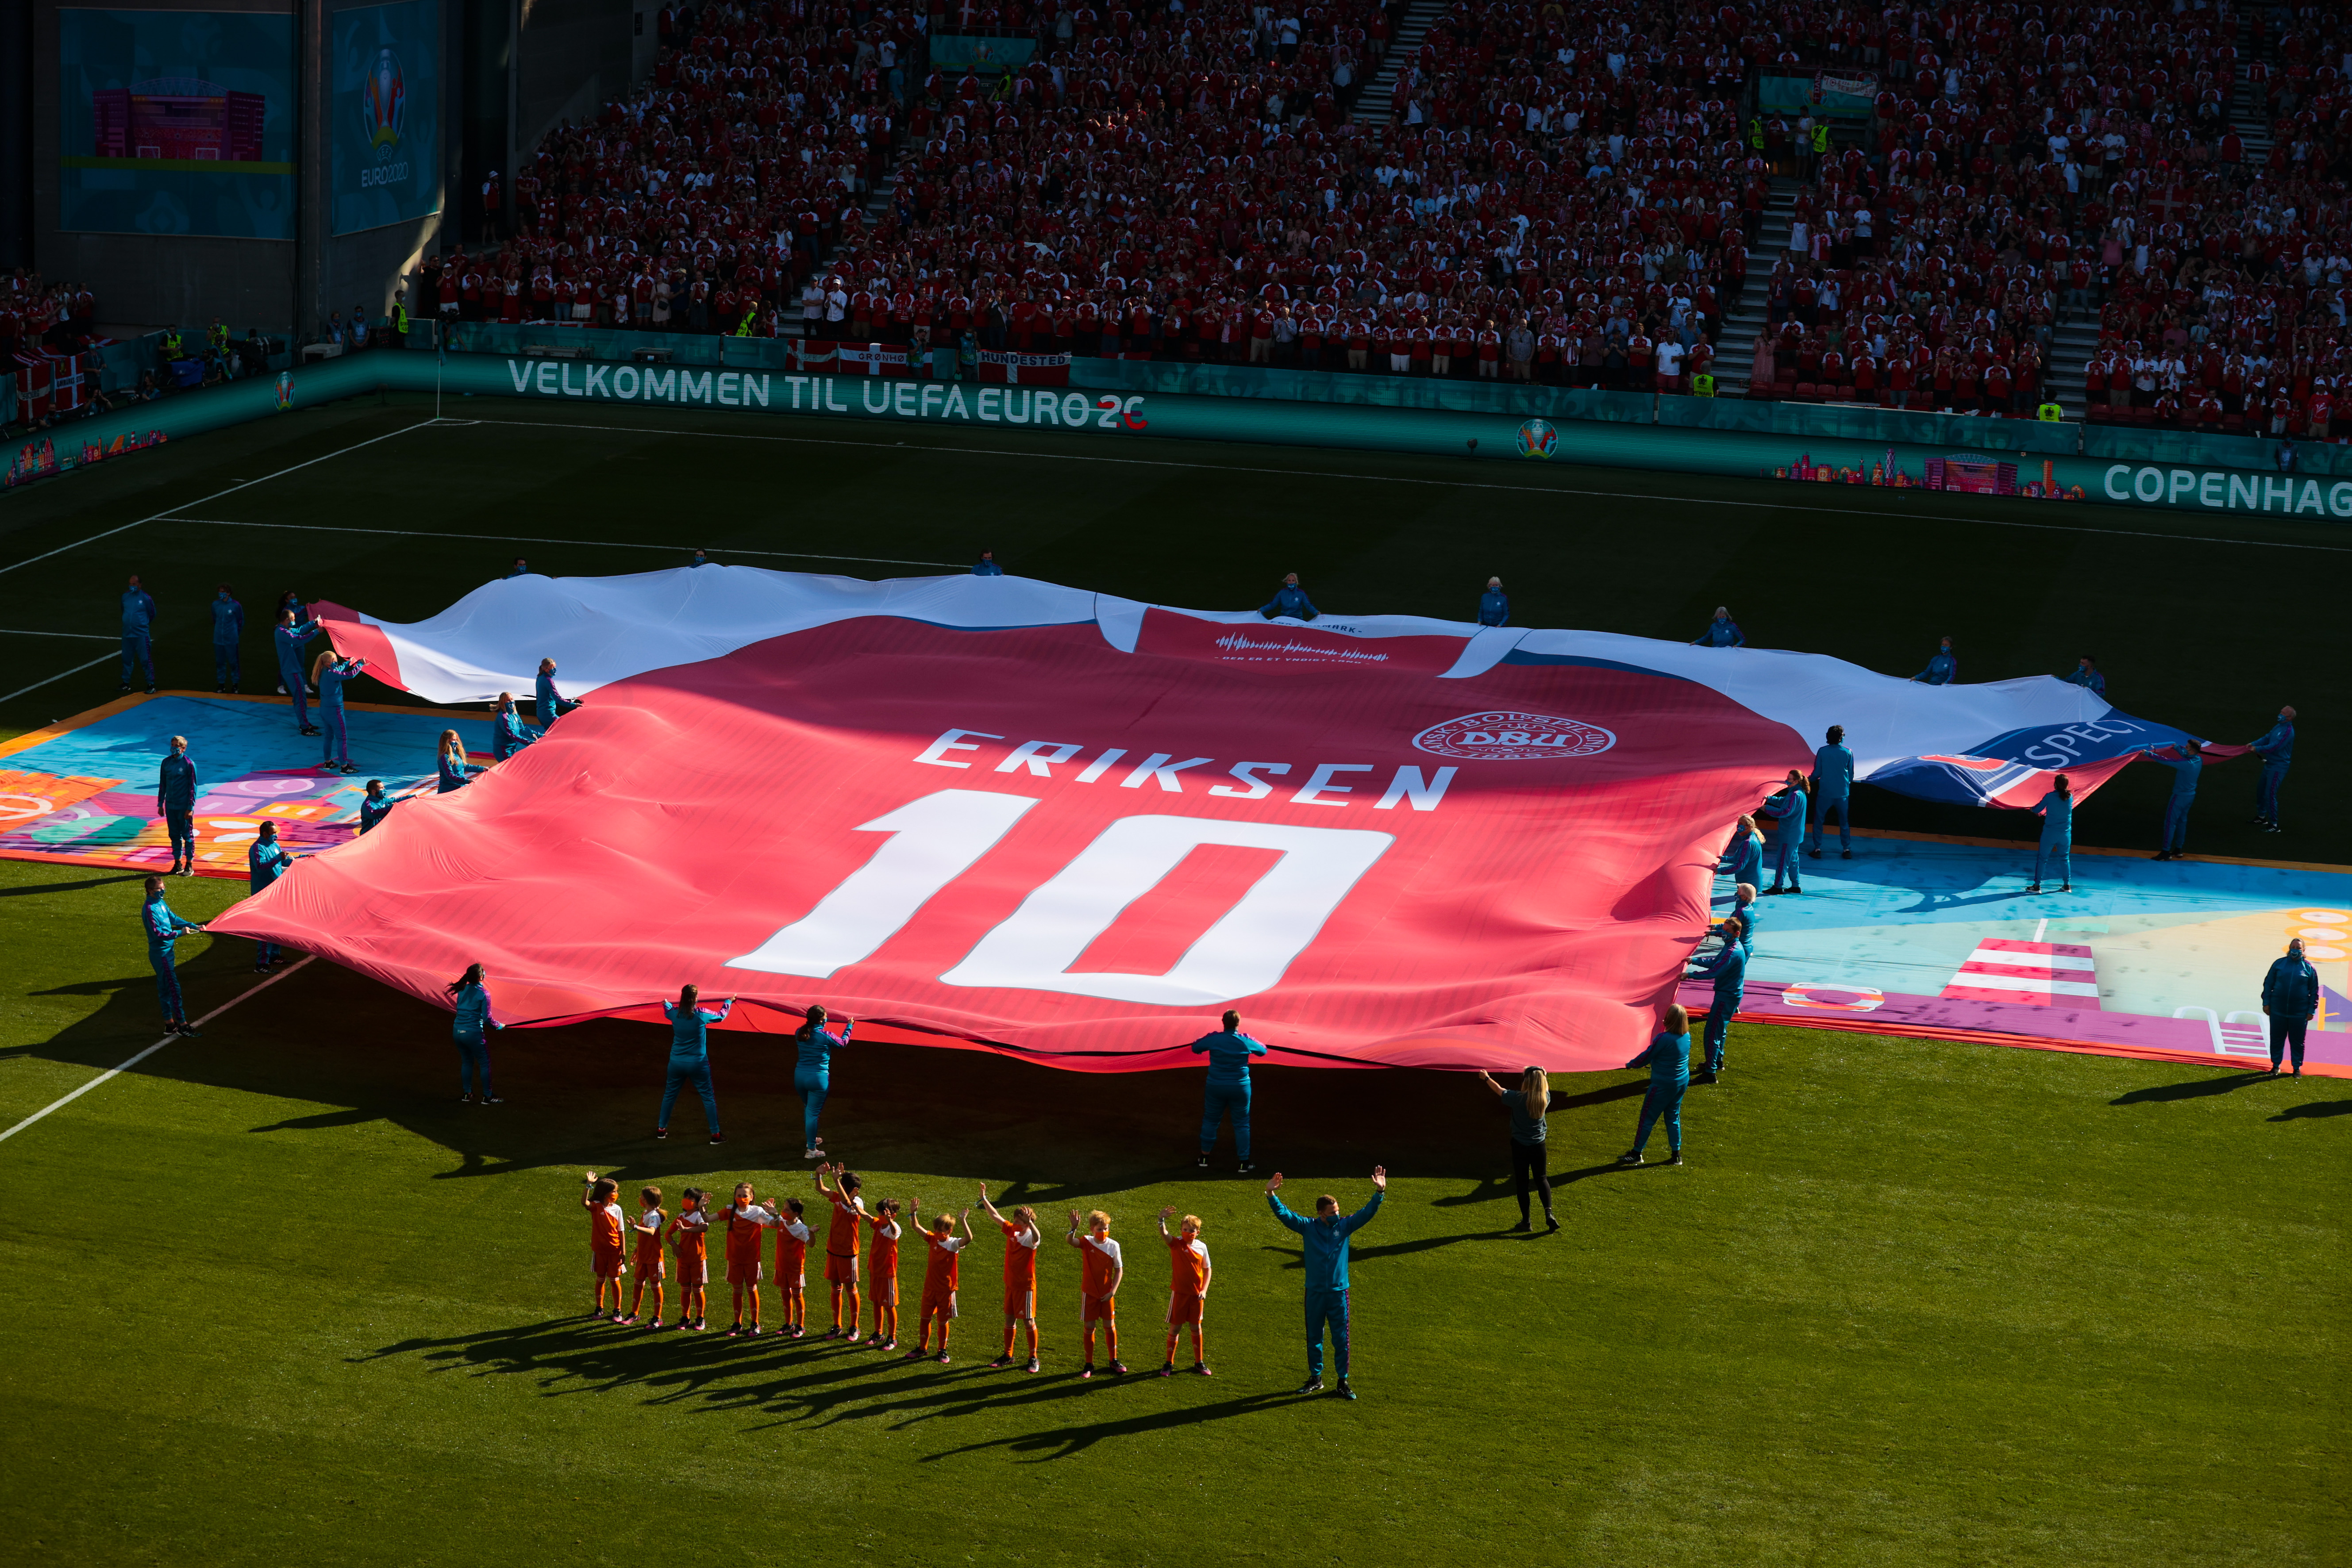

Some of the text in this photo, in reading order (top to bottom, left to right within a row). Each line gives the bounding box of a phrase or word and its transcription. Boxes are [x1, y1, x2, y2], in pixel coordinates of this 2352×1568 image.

[362, 161, 408, 187] EURO2020
[858, 353, 904, 362] GRØNHØ
[981, 352, 1065, 365] HUNDESTED
[508, 359, 770, 407] VELKOMMEN
[785, 376, 847, 411] TIL
[863, 380, 969, 419] UEFA
[978, 388, 1089, 427] EURO
[2104, 464, 2352, 517] COPENHAG
[1455, 731, 1572, 747] DBU
[912, 728, 1459, 811] ERIKSEN
[720, 788, 1397, 1007] 10
